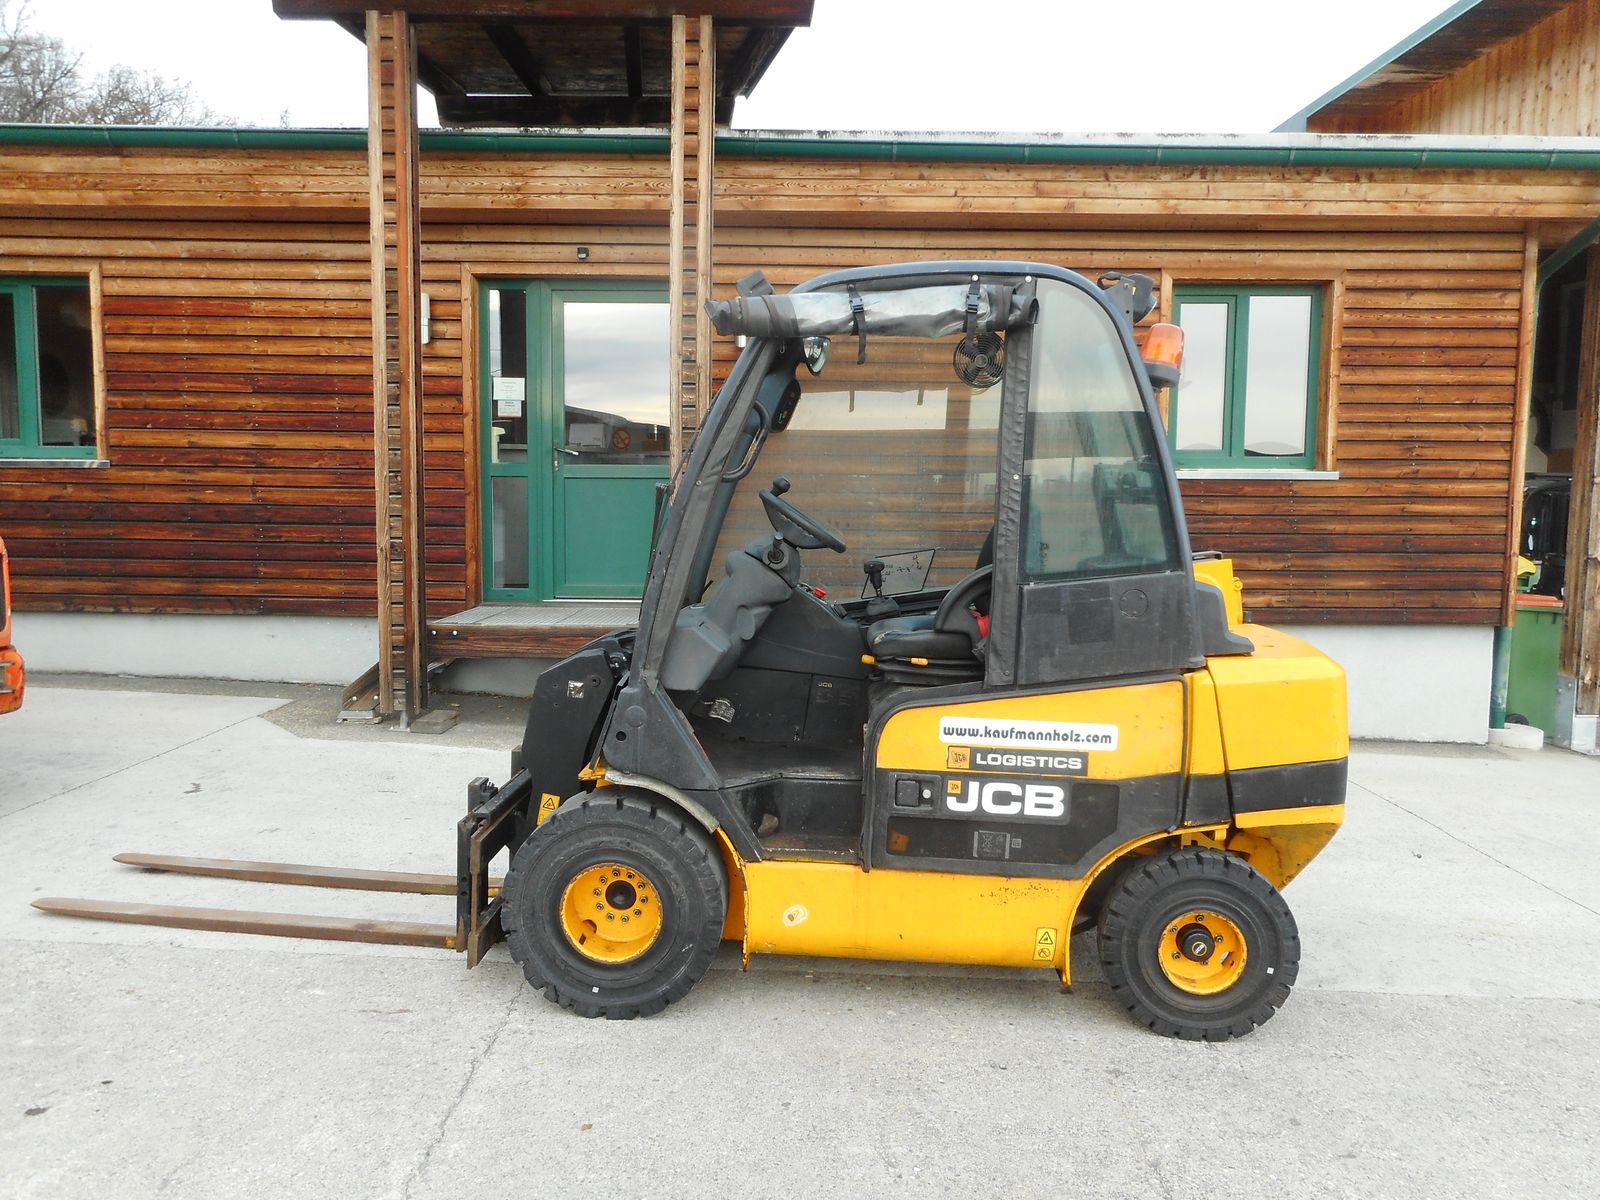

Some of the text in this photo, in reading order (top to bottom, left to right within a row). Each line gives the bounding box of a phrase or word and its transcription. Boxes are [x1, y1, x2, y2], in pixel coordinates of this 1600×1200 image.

[943, 726, 1112, 744] www.kaufmannholz.com
[954, 752, 1082, 770] JCB LOGISTICS
[946, 781, 1065, 817] JCB
